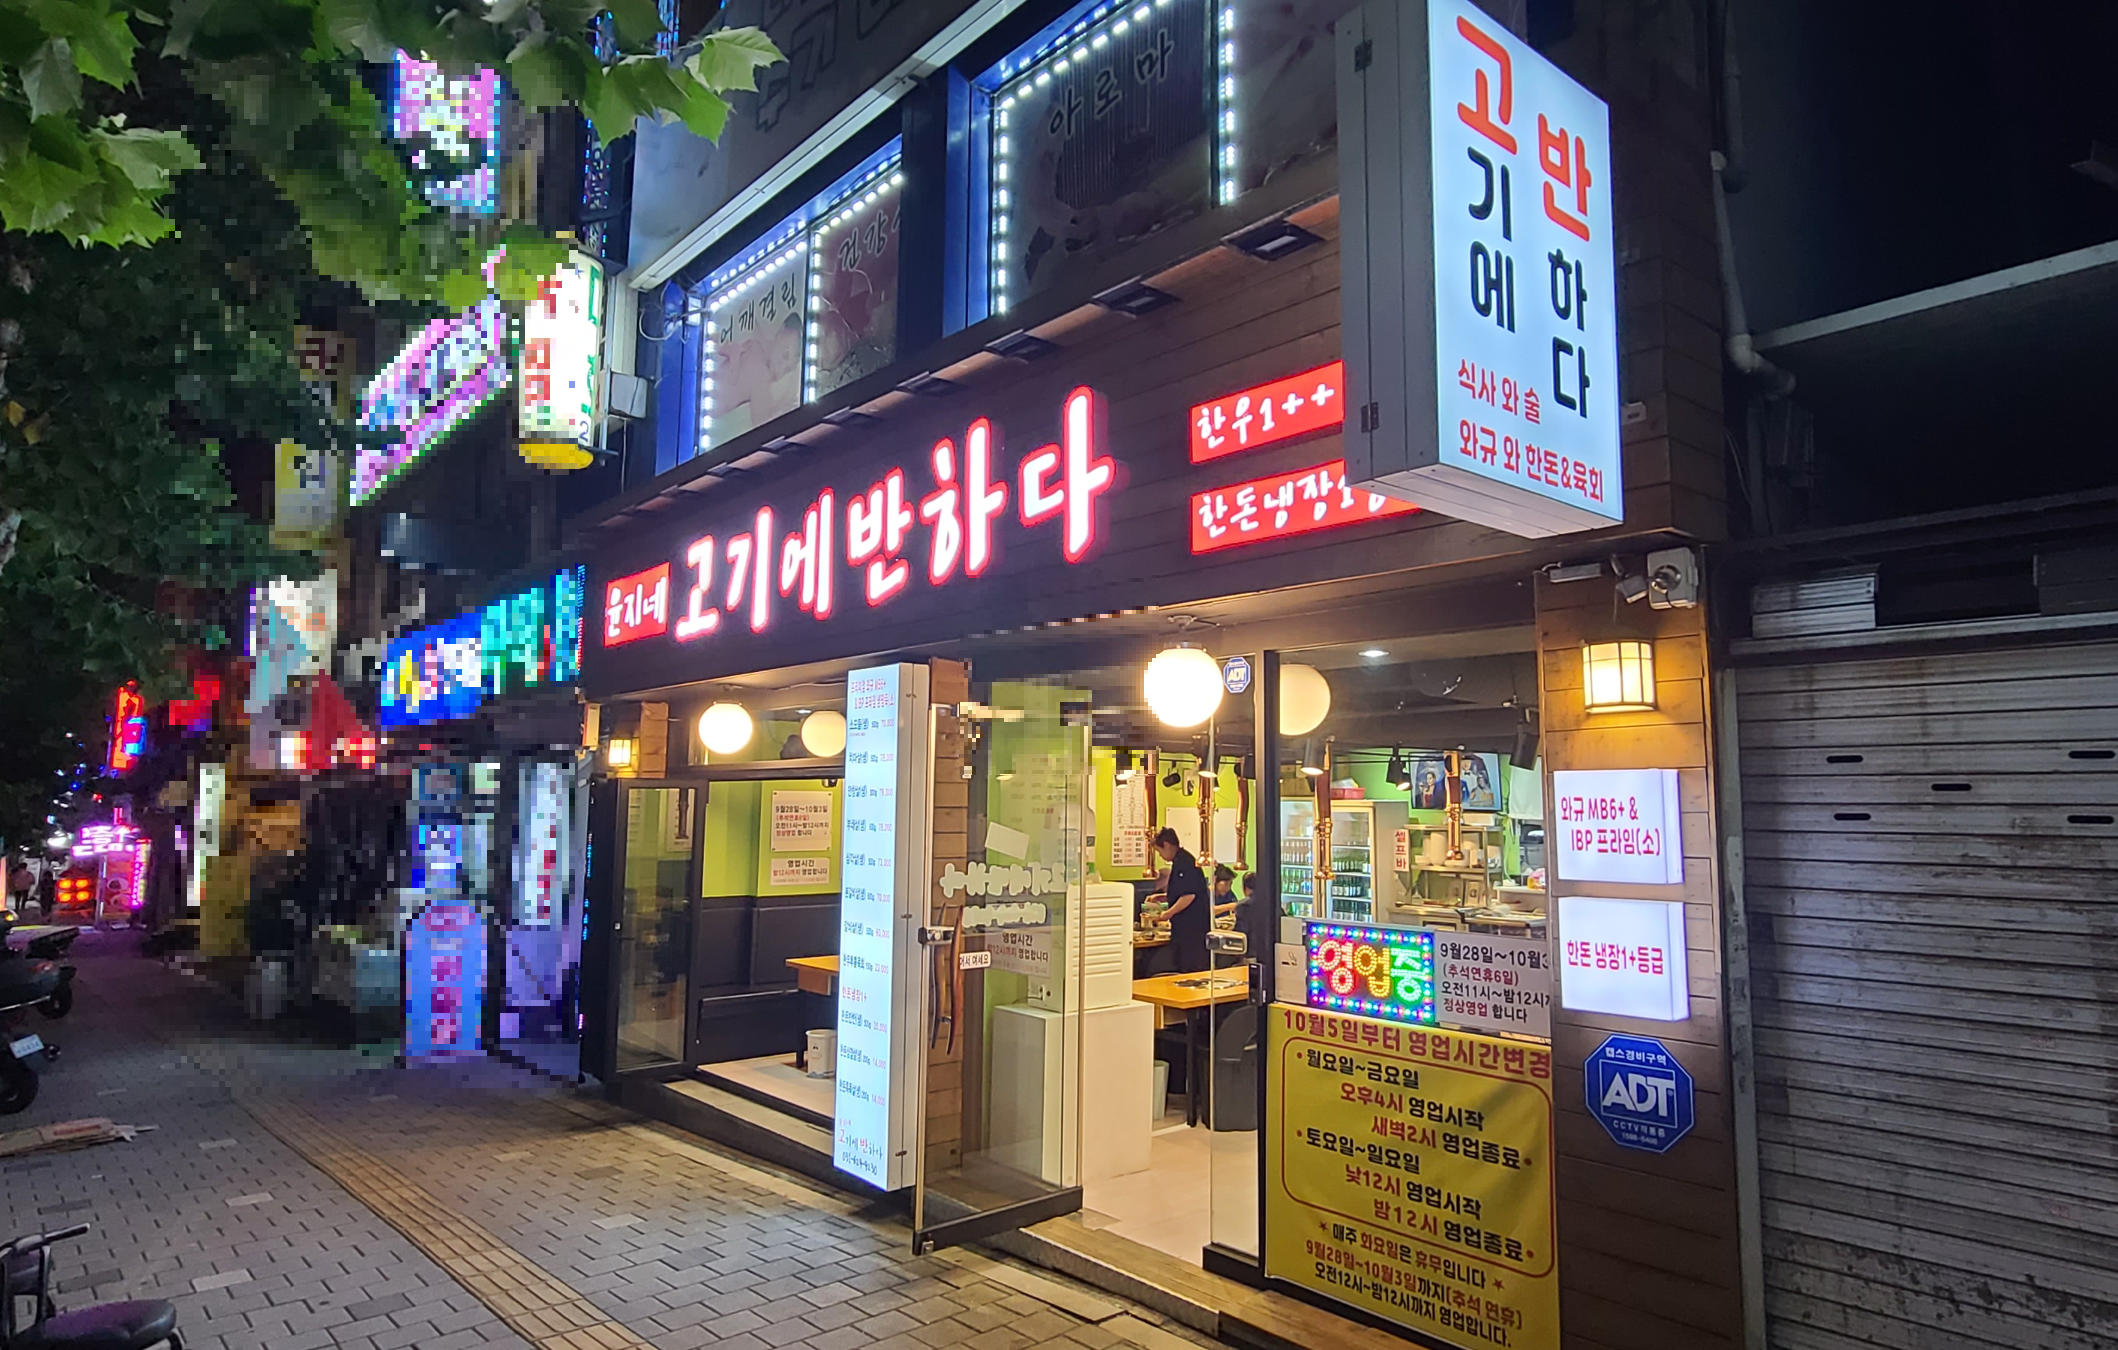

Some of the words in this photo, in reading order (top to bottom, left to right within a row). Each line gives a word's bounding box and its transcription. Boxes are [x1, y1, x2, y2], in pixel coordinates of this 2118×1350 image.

[1049, 28, 1175, 140] 아로마
[1456, 14, 1518, 334] 고기에
[1537, 112, 1593, 419] 반하다
[720, 272, 797, 344] 어깨결림
[1458, 358, 1497, 408] 식사
[1501, 376, 1519, 417] 와
[1523, 386, 1541, 425] 술
[1196, 383, 1335, 450] 한우1++
[1459, 418, 1498, 467] 와규
[1503, 435, 1521, 475] 와
[1524, 442, 1604, 504] 한돈&육회
[606, 576, 668, 638] 윤지네
[674, 384, 1117, 645] 고기에반하다
[1227, 667, 1246, 682] ADT
[1560, 796, 1584, 822] 와규
[1588, 797, 1625, 821] MB6+
[1629, 796, 1639, 821] &
[787, 859, 815, 868] 영업시간
[1395, 830, 1406, 870] 셀프바
[1571, 828, 1593, 851] IBP
[1597, 827, 1661, 857] 프라임(소)
[1002, 932, 1033, 947] 영업시간
[1567, 939, 1592, 968] 한돈
[1594, 941, 1665, 976] 냉장1+등급
[1317, 939, 1428, 1002] 영업중
[1443, 962, 1519, 987] (추석연휴6일)
[1443, 998, 1488, 1018] 정상영업
[1491, 1003, 1528, 1024] 합니다
[1283, 1010, 1401, 1053] 10월5일부터
[1408, 1030, 1551, 1080] 영업시간변경
[1306, 1047, 1421, 1091] 월요일~금요일
[1340, 1081, 1403, 1114] 오후4시
[1408, 1096, 1485, 1131] 영업시작
[1602, 1071, 1675, 1118] ADT
[1306, 1127, 1421, 1175] 토요일~일요일
[1371, 1114, 1438, 1149] 새벽2시
[1442, 1131, 1522, 1171] 영업종료
[1406, 1180, 1482, 1221] 영업시작
[1332, 1222, 1358, 1244] 매주
[1360, 1230, 1412, 1265] 화요일은
[1415, 1249, 1487, 1290] 휴무입니다
[1443, 1219, 1525, 1262] 영업종료
[1314, 1261, 1437, 1322] 오전12시~밤12시까지
[1439, 1306, 1512, 1349] 영업합니다.
